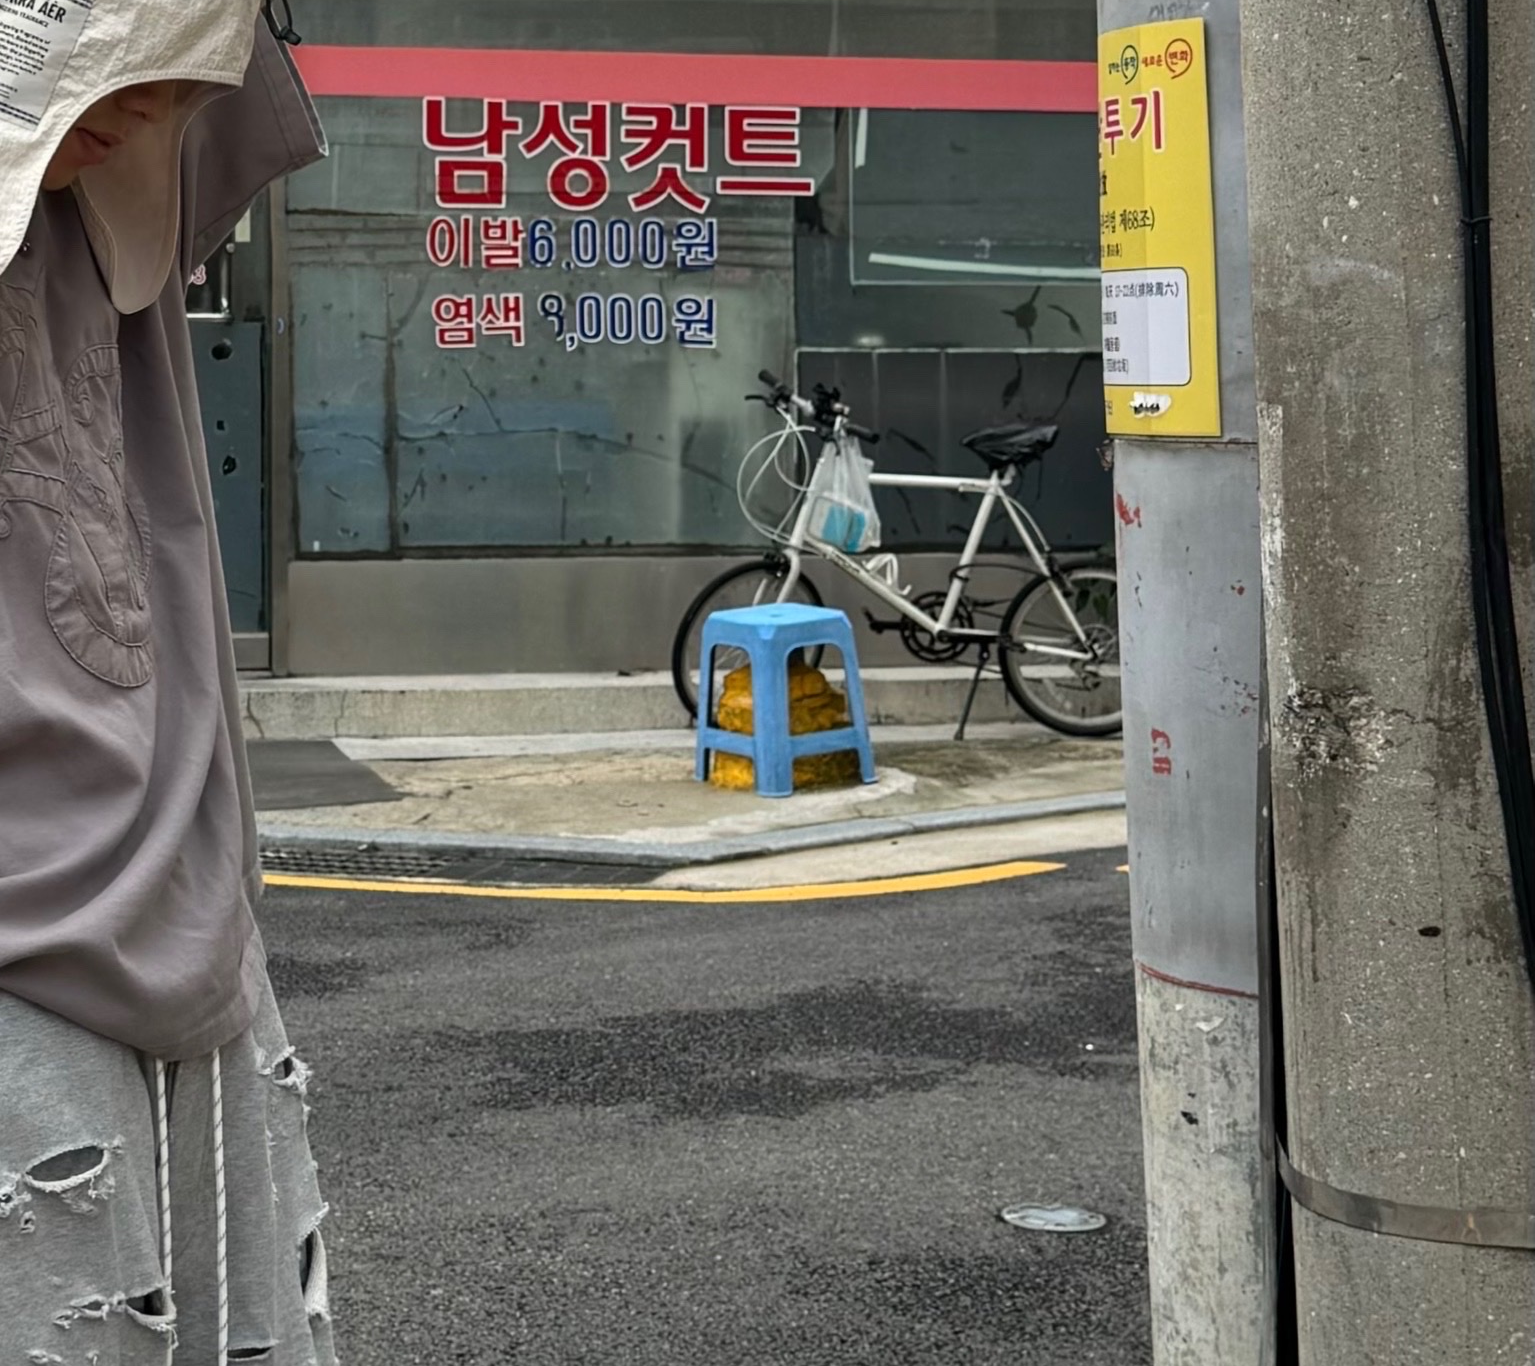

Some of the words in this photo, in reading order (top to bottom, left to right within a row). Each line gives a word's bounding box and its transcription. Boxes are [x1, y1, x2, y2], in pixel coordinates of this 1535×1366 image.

[1169, 50, 1189, 65] 변화
[1103, 89, 1163, 157] 투기
[423, 96, 816, 212] 남성컷트
[432, 293, 525, 348] 염색
